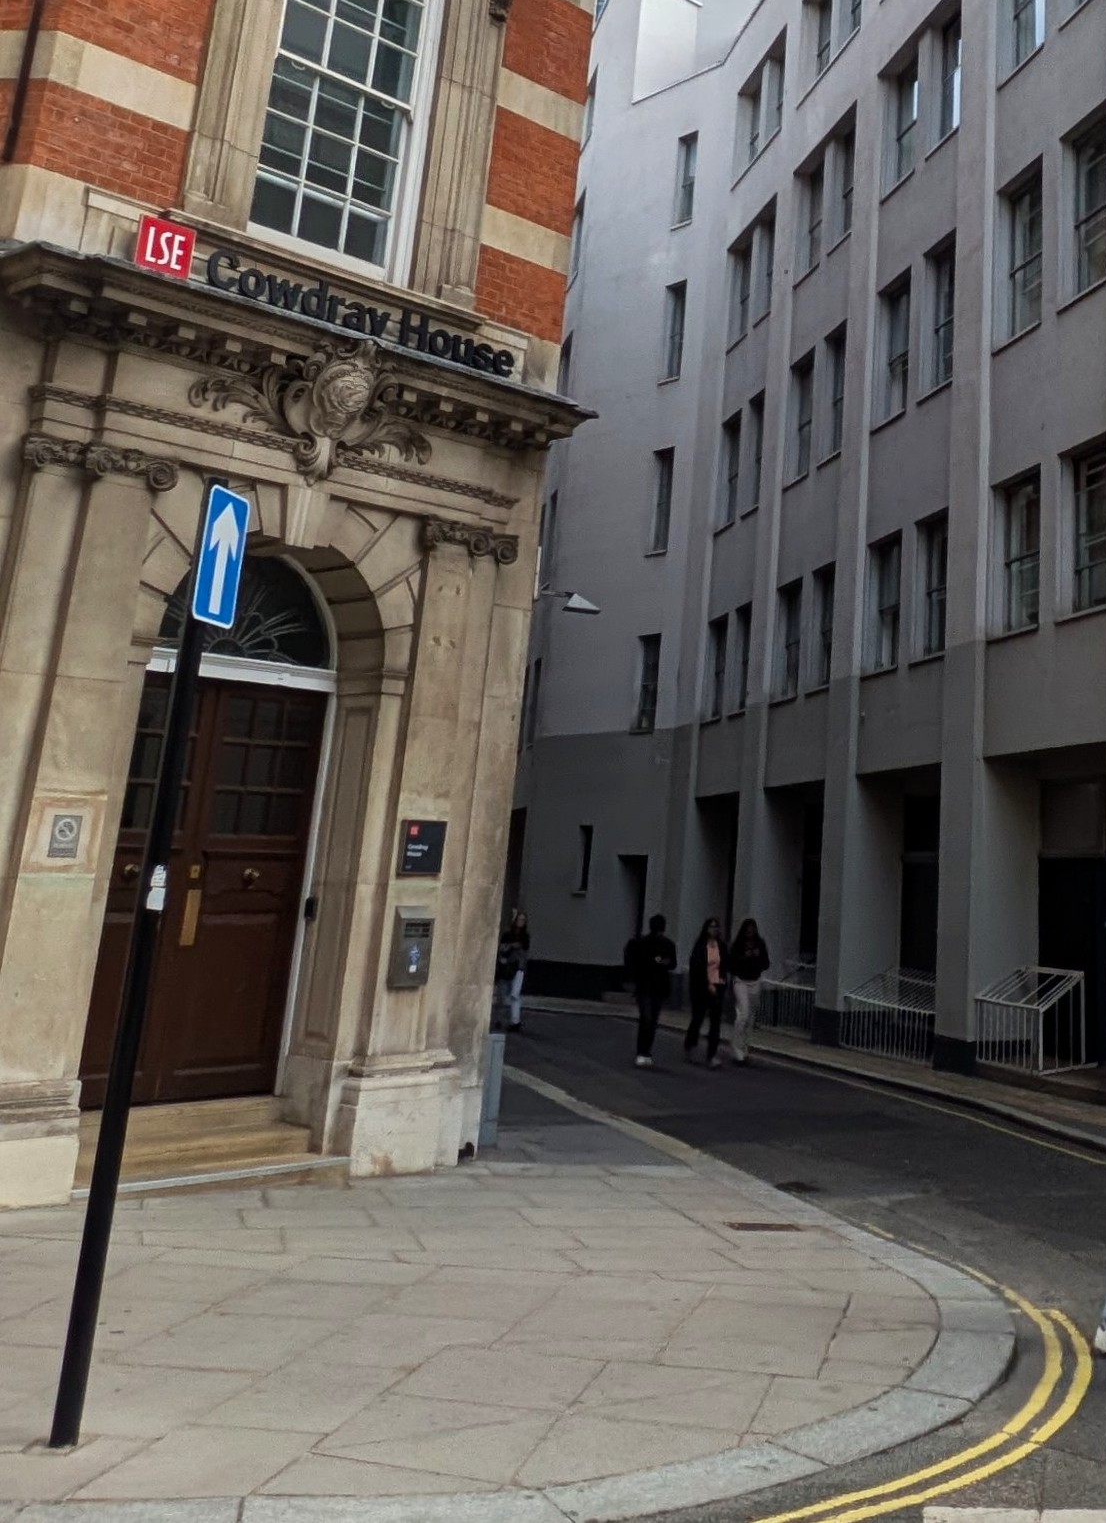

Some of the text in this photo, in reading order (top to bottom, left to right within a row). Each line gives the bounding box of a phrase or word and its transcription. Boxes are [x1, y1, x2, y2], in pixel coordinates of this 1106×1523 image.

[145, 226, 187, 271] LSE
[207, 248, 515, 378] Cowdray House
